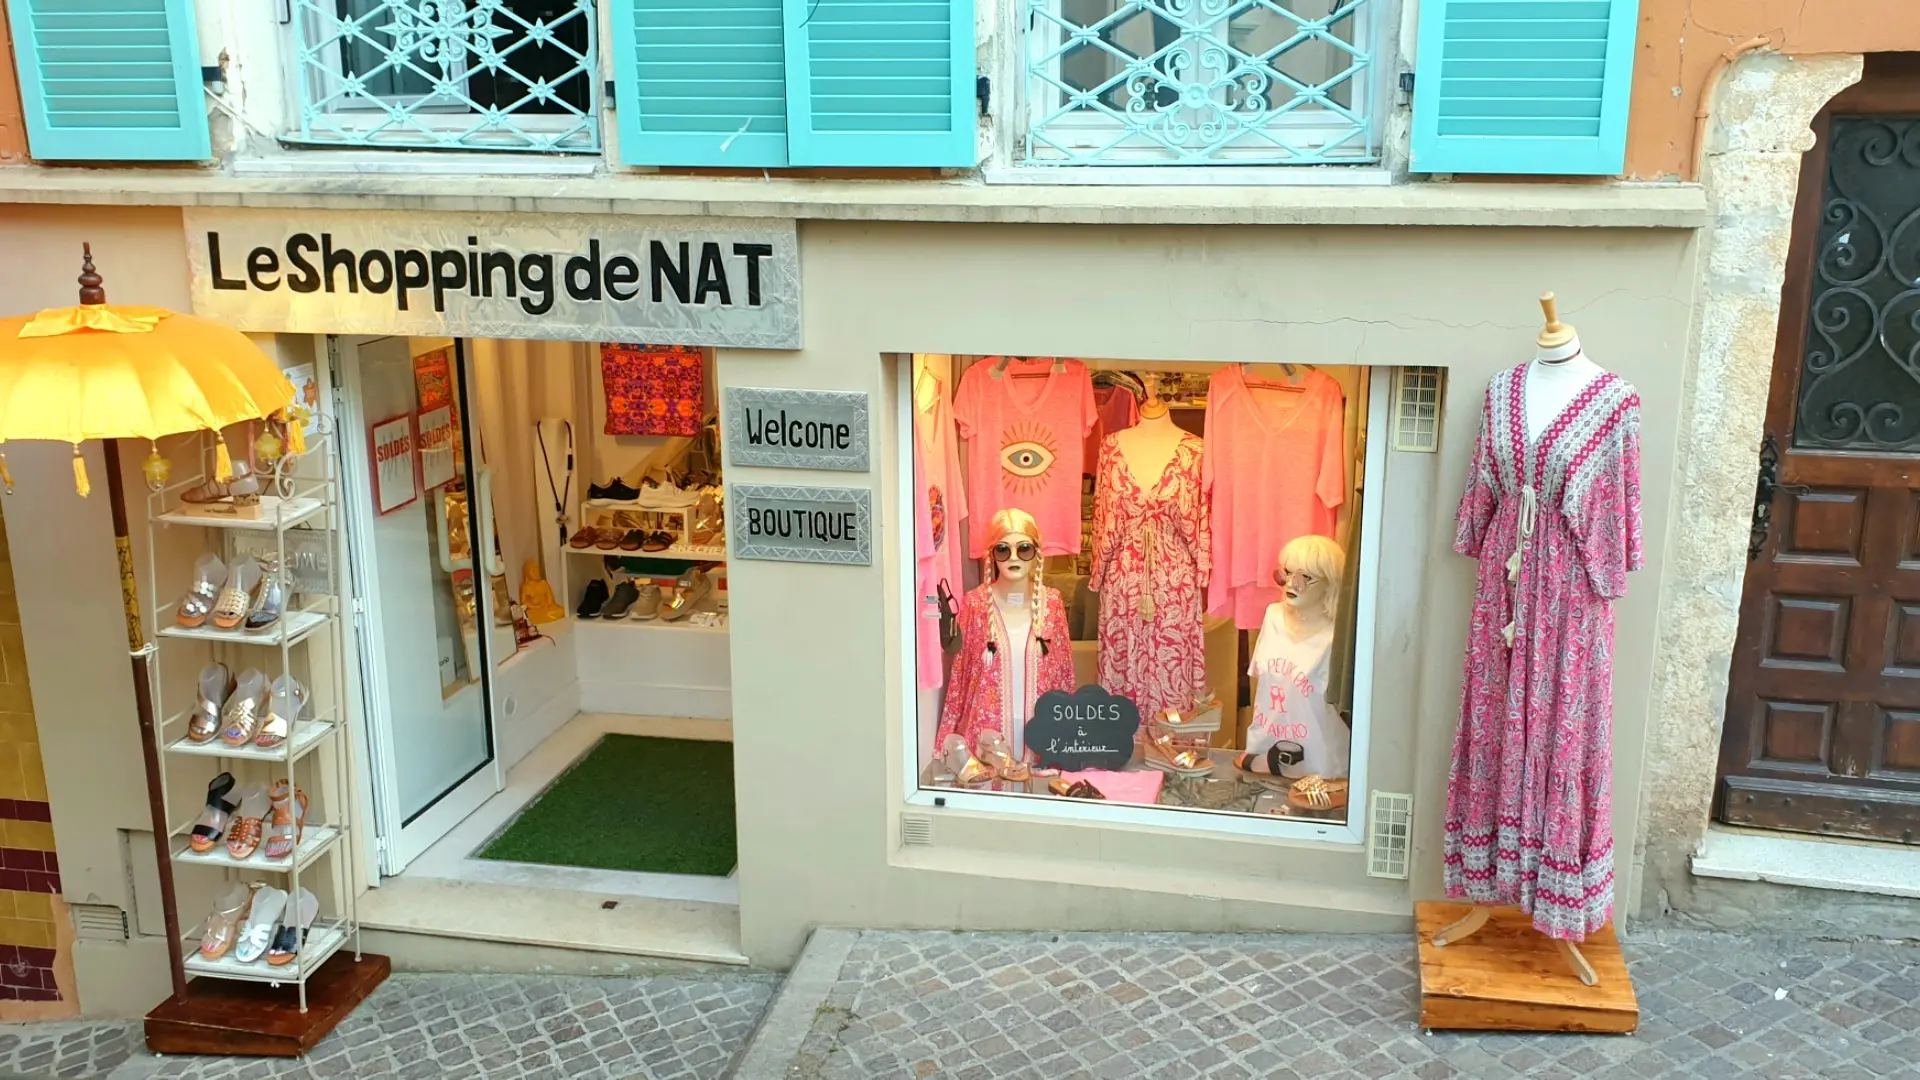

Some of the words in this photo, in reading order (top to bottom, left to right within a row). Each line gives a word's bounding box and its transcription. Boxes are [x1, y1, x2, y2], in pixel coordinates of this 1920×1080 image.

[286, 232, 553, 315] Shopping
[565, 238, 639, 302] de
[649, 239, 773, 307] NAT
[420, 422, 451, 449] SOLDES
[745, 407, 850, 450] Welcome
[377, 435, 410, 463] SOLDES
[748, 507, 856, 542] BOUTIQUE
[1267, 657, 1298, 677] PEUX
[1293, 671, 1315, 698] PAS
[1053, 704, 1120, 721] SOLDES
[1077, 725, 1087, 736] à
[1046, 738, 1119, 754] l'intérieur
